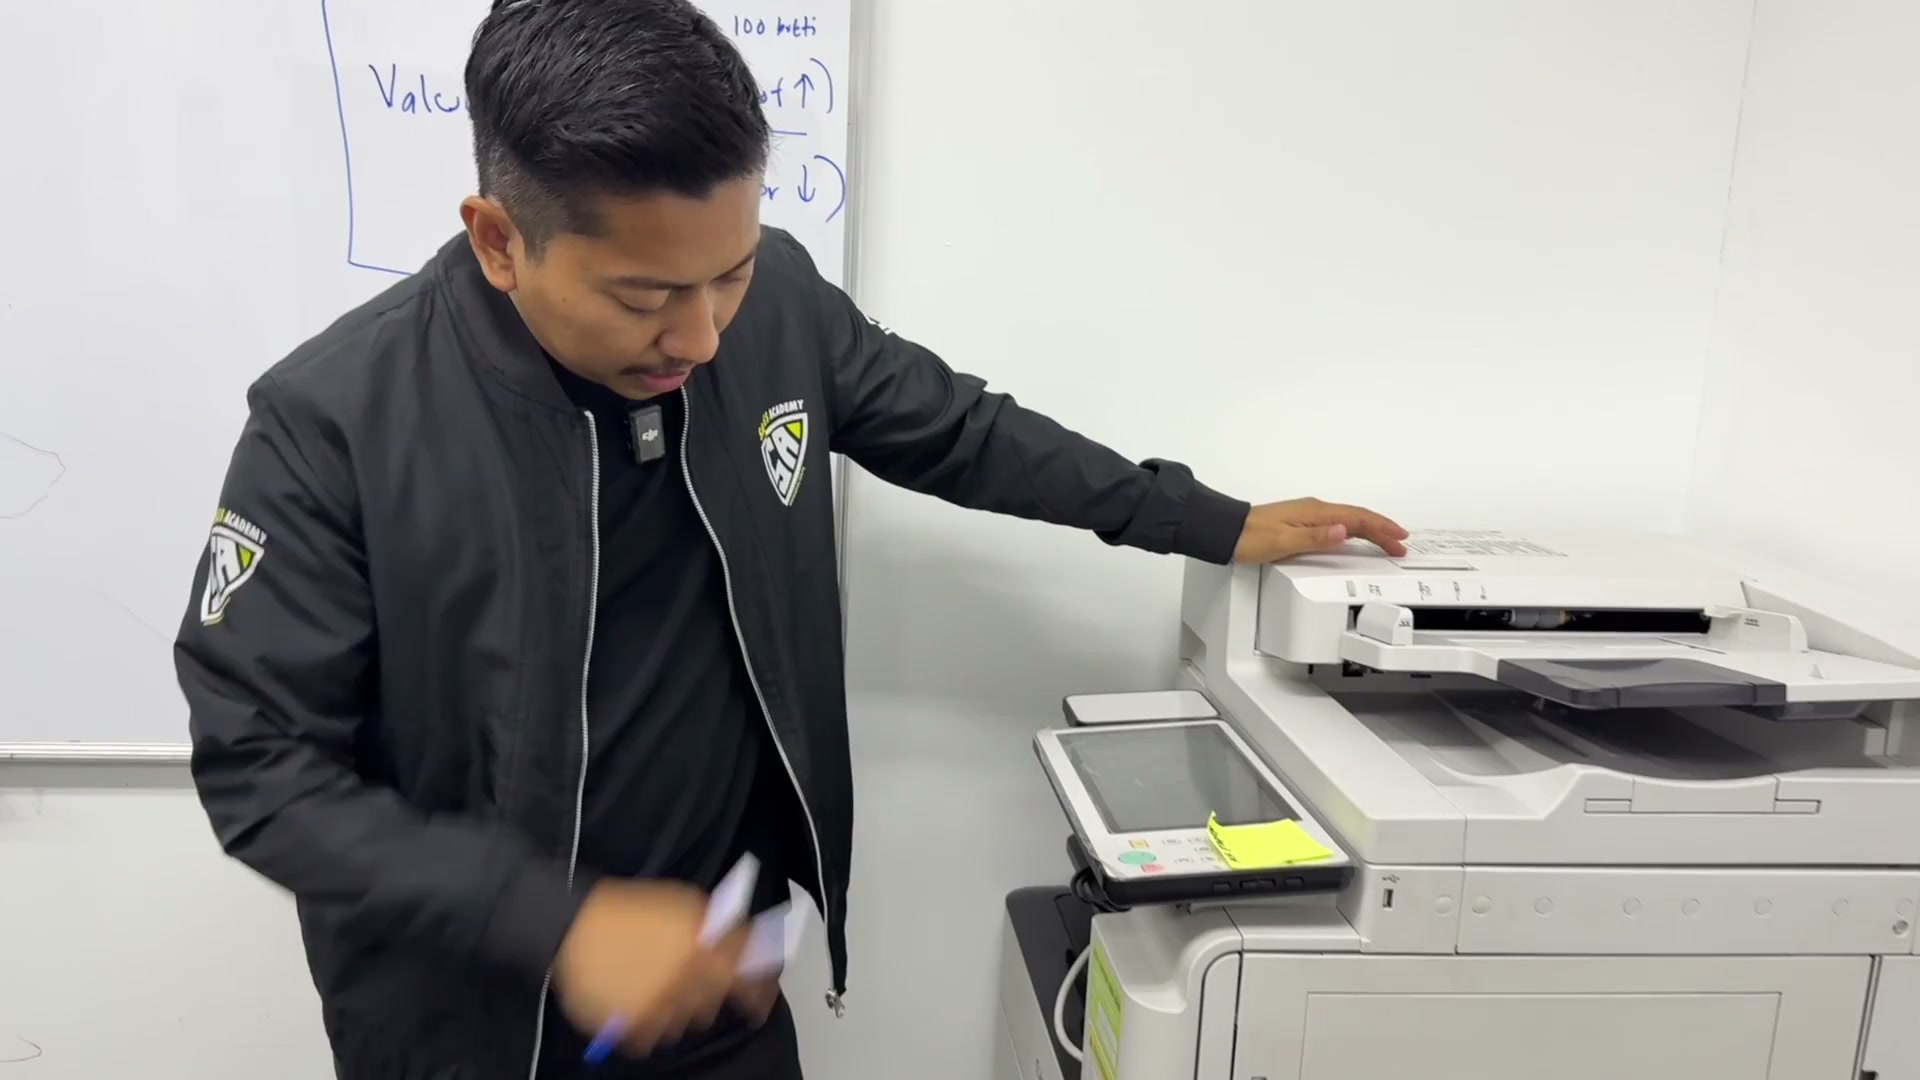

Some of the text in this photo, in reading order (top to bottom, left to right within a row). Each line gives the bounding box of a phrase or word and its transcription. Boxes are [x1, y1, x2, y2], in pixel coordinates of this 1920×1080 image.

[734, 15, 766, 36] 100
[368, 63, 468, 115] Valu
[768, 399, 804, 421] ACADEMY
[223, 509, 268, 545] ACADEMY
